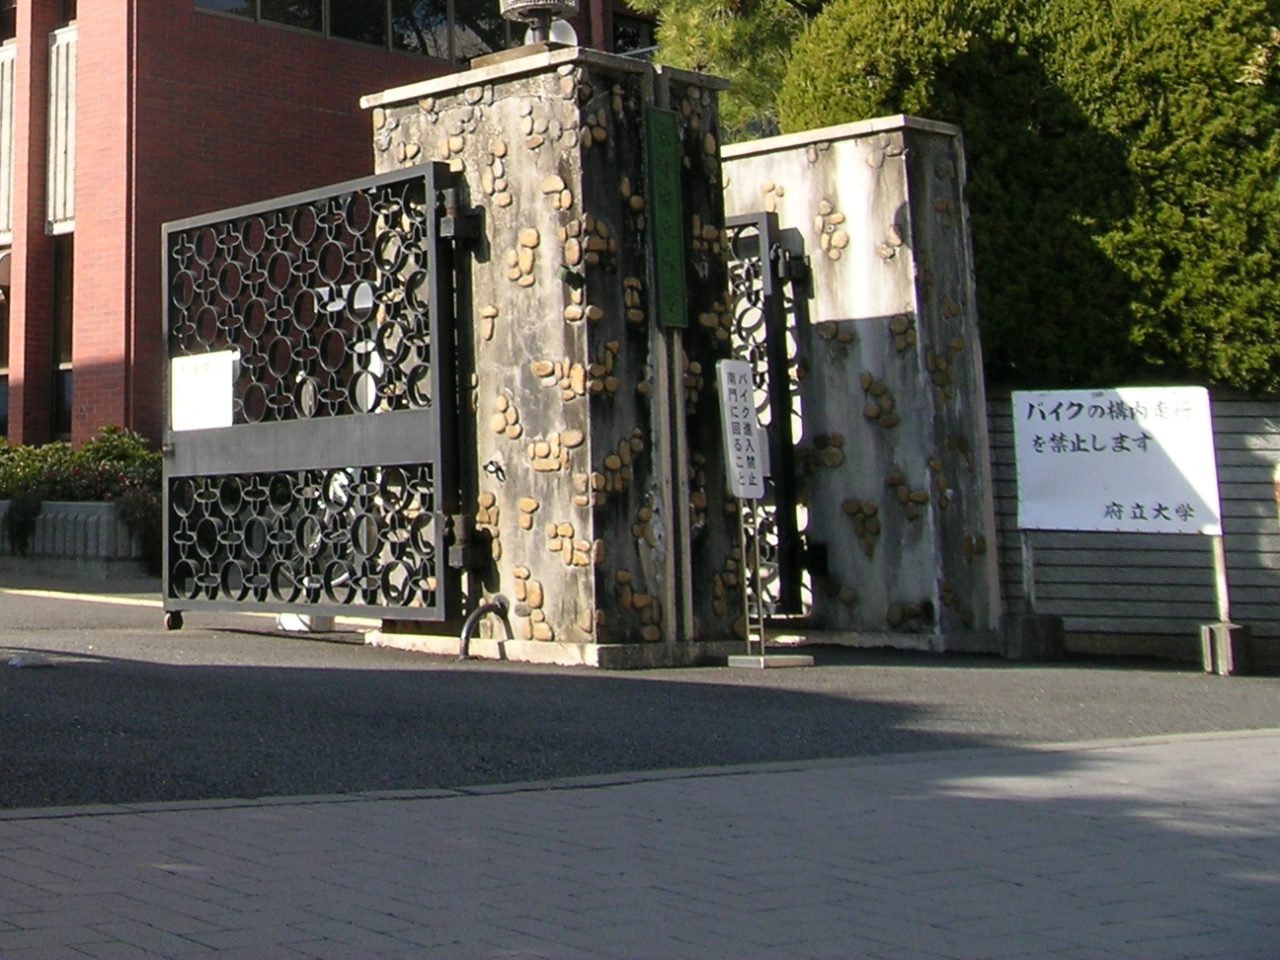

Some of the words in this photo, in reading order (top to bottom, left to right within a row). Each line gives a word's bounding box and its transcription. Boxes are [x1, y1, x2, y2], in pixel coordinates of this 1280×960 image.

[1026, 399, 1193, 422] バイクの構内走行
[726, 372, 746, 486] 南門に回ること
[738, 373, 758, 486] バイク進入禁止
[1032, 433, 1154, 453] を禁止します
[1103, 501, 1195, 522] 府立大学
